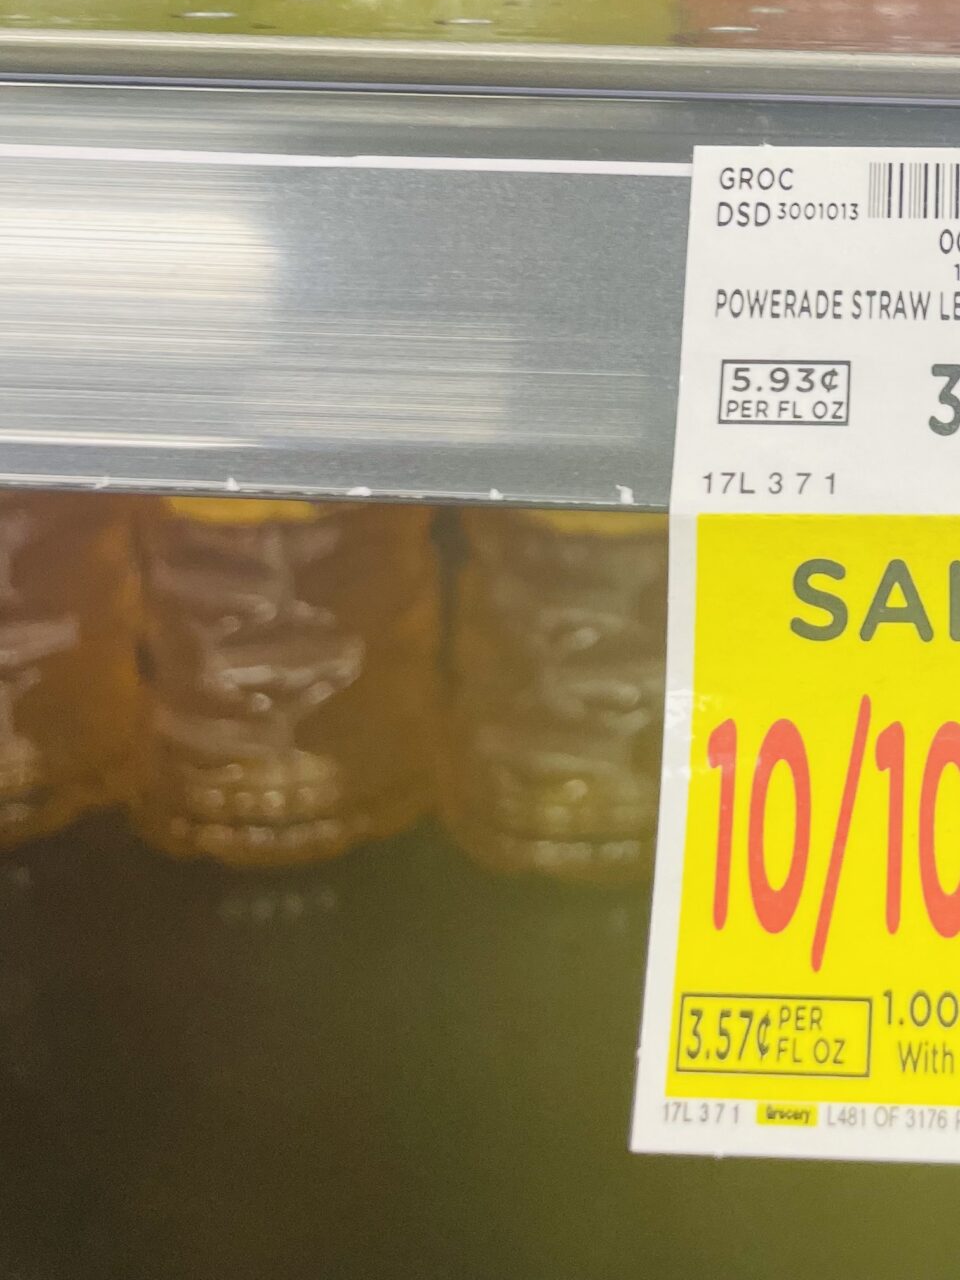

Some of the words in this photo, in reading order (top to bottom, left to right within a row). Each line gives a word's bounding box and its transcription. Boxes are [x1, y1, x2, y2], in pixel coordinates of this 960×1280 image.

[720, 167, 794, 191] GROC
[716, 202, 771, 227] DSD
[777, 203, 859, 220] 3001013
[716, 289, 843, 319] POWERADE
[851, 290, 931, 320] STRAW
[731, 366, 840, 393] 5.93¢
[726, 400, 771, 420] PER
[778, 400, 801, 420] FL
[812, 401, 844, 421] OZ
[703, 473, 755, 495] 17L
[778, 1005, 823, 1032] PER
[883, 989, 959, 1028] 1.00
[687, 1008, 771, 1061] 3.57¢
[776, 1038, 803, 1063] FL
[813, 1038, 846, 1065] OZ
[898, 1041, 955, 1074] With
[766, 1105, 811, 1125] Grocery
[874, 1107, 900, 1128] OF
[905, 1109, 948, 1131] 3176
